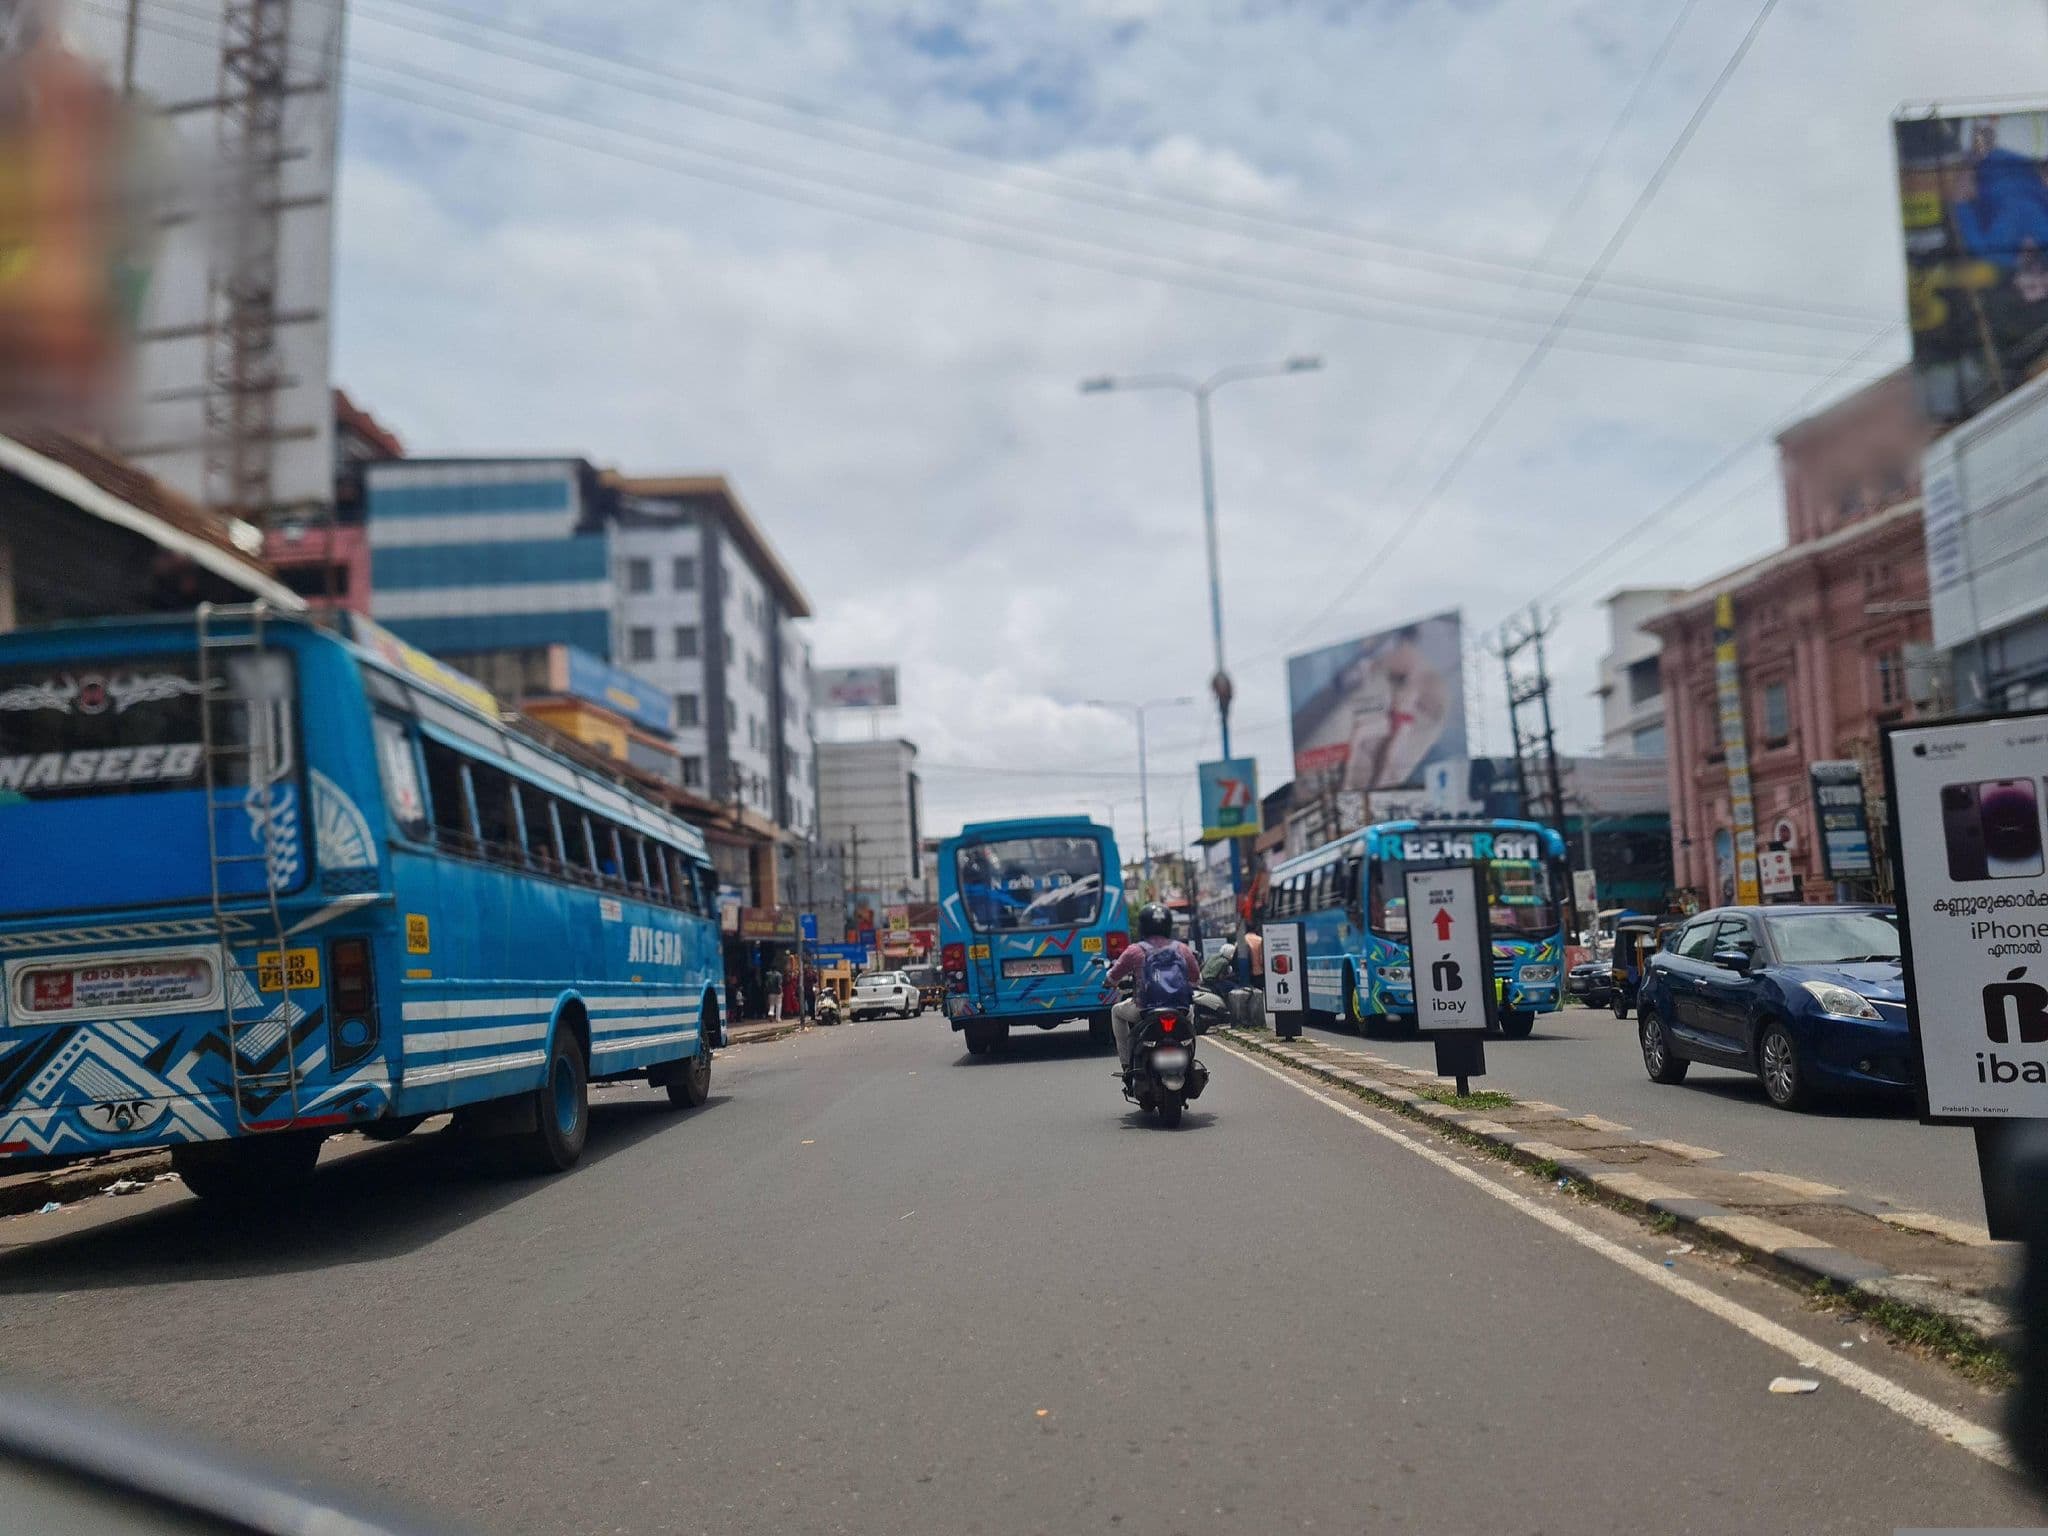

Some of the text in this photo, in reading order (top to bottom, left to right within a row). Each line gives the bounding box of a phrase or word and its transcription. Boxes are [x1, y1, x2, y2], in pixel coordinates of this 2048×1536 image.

[1971, 921, 2048, 939] iPhone
[1988, 940, 2042, 958] എന്നാൽ
[1432, 998, 1466, 1014] ibay
[1976, 1052, 2048, 1083] iba
